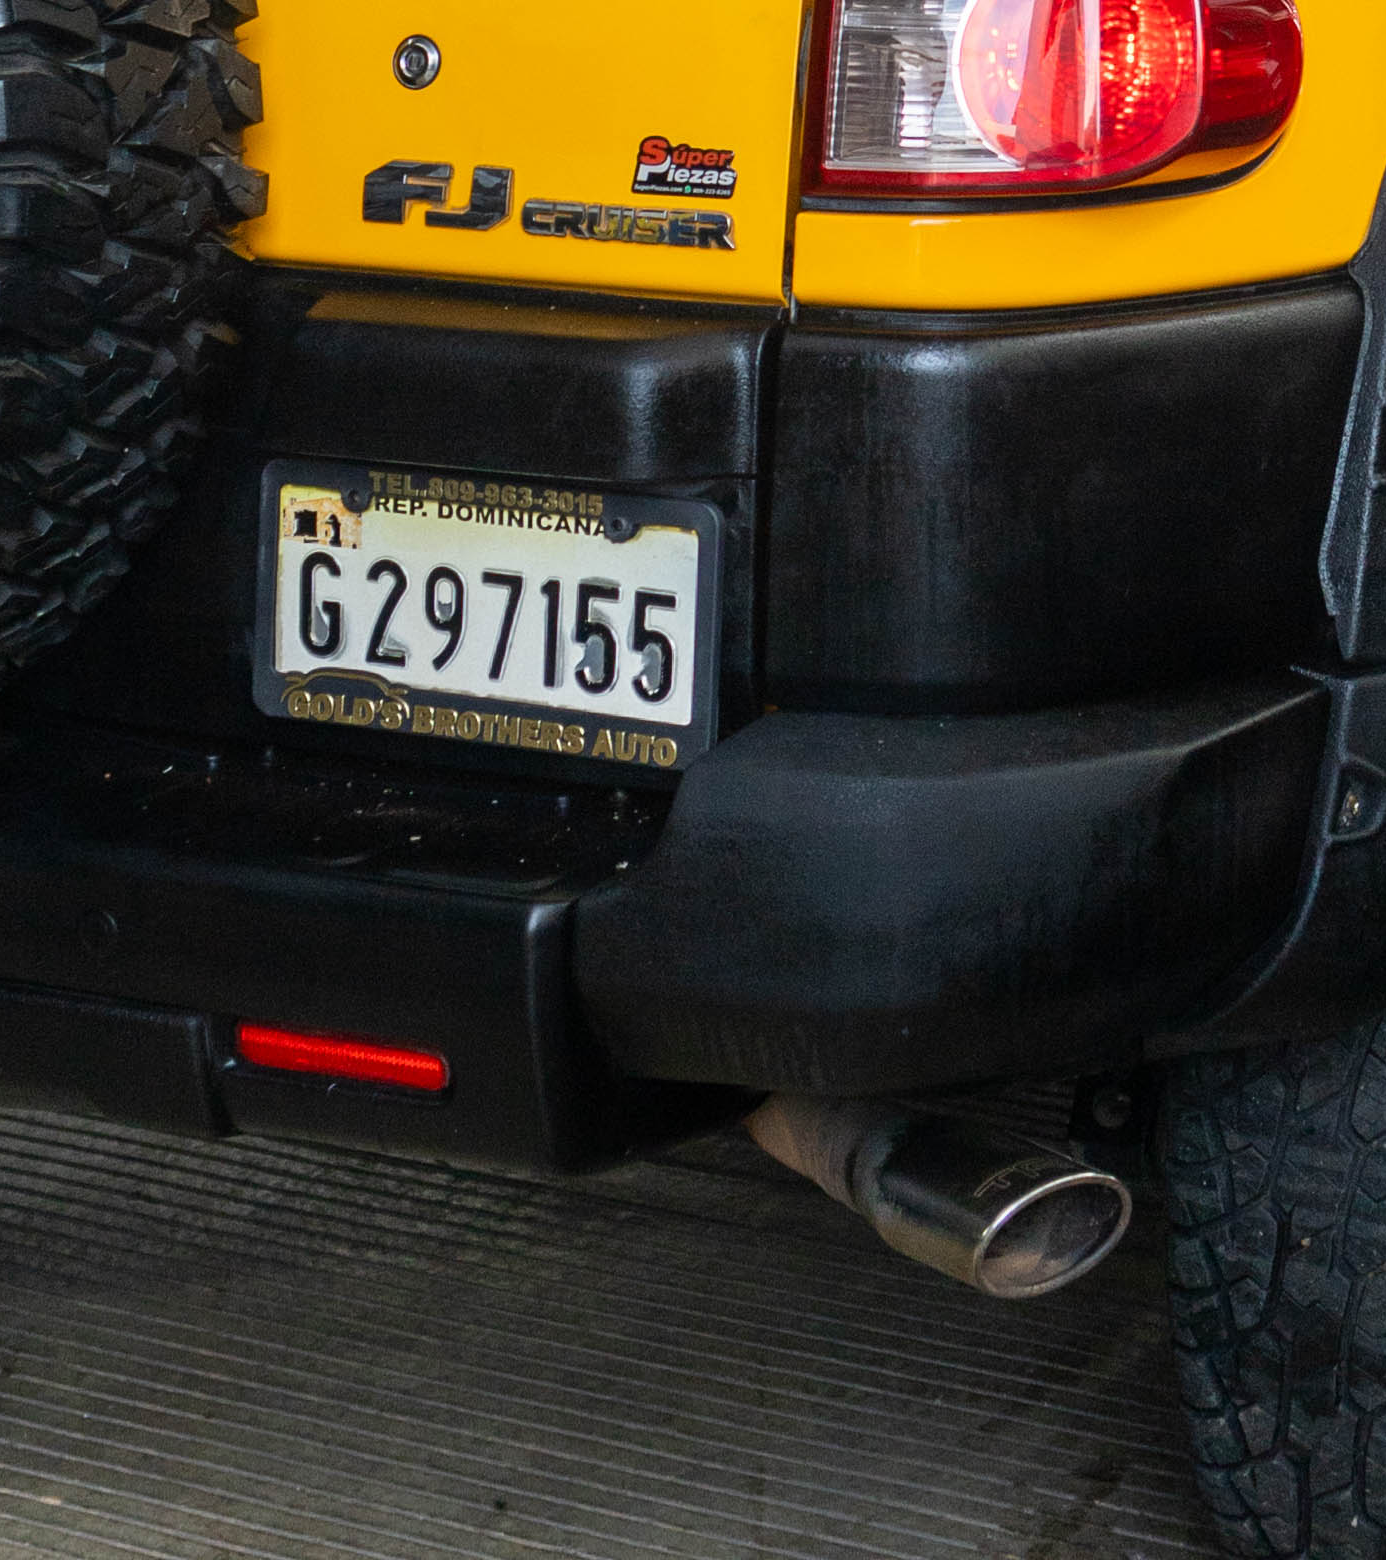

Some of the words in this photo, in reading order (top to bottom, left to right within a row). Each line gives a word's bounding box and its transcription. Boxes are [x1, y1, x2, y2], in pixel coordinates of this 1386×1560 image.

[363, 159, 513, 231] FJ
[522, 198, 736, 251] CRUISER
[636, 155, 736, 186] Piezas
[374, 496, 428, 518] REP.
[438, 502, 607, 538] DOMINICANA
[298, 551, 679, 704] G297155
[287, 690, 407, 730] GOLD'S
[413, 704, 585, 753] BROTHERS
[592, 728, 678, 768] AUTO
